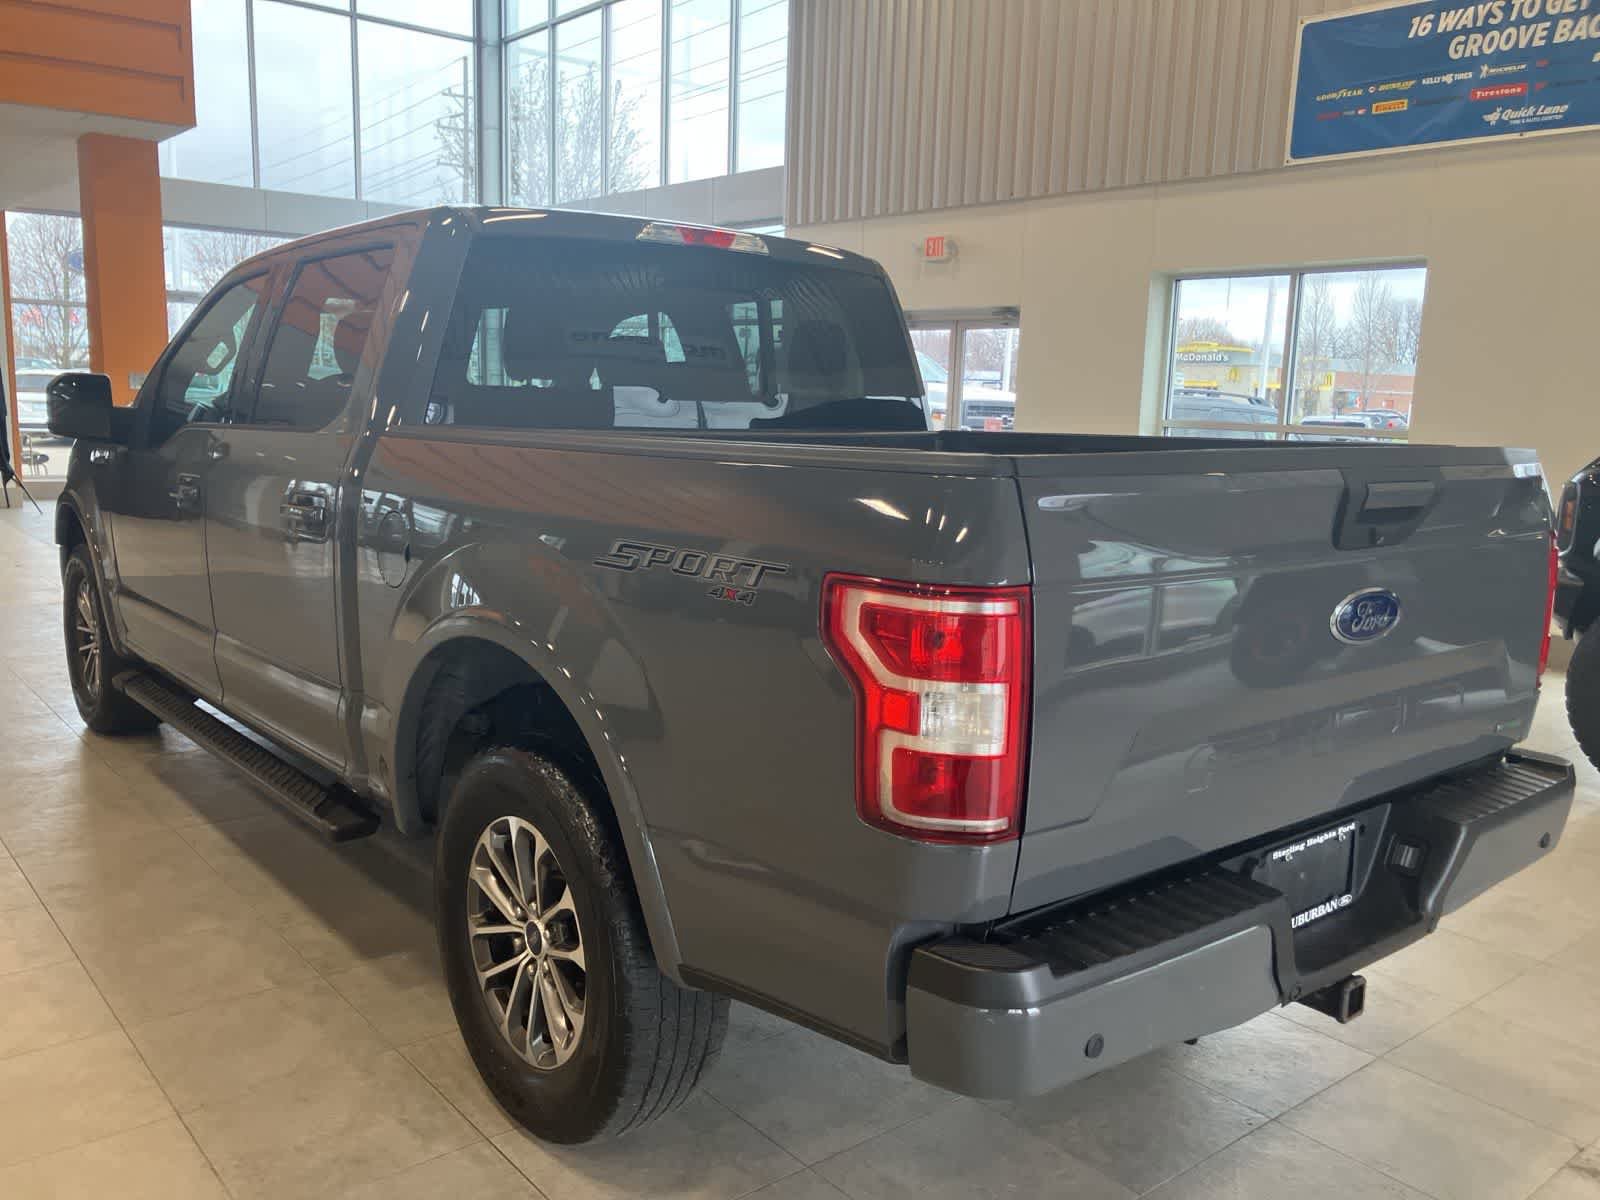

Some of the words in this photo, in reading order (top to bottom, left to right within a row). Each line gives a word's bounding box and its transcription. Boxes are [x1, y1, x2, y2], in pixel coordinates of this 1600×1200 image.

[1407, 13, 1435, 38] 16
[1437, 1, 1505, 33] WAYS
[1509, 0, 1541, 21] TO
[1448, 21, 1552, 60] GROOVE
[1501, 105, 1536, 120] Quick
[1535, 104, 1569, 116] Lane
[926, 237, 944, 257] EXIT
[1176, 352, 1230, 362] McDonald's
[592, 538, 791, 589] SPORT
[1351, 601, 1392, 633] Ford
[1338, 822, 1356, 836] Ford
[1291, 898, 1338, 929] UBURBAN
